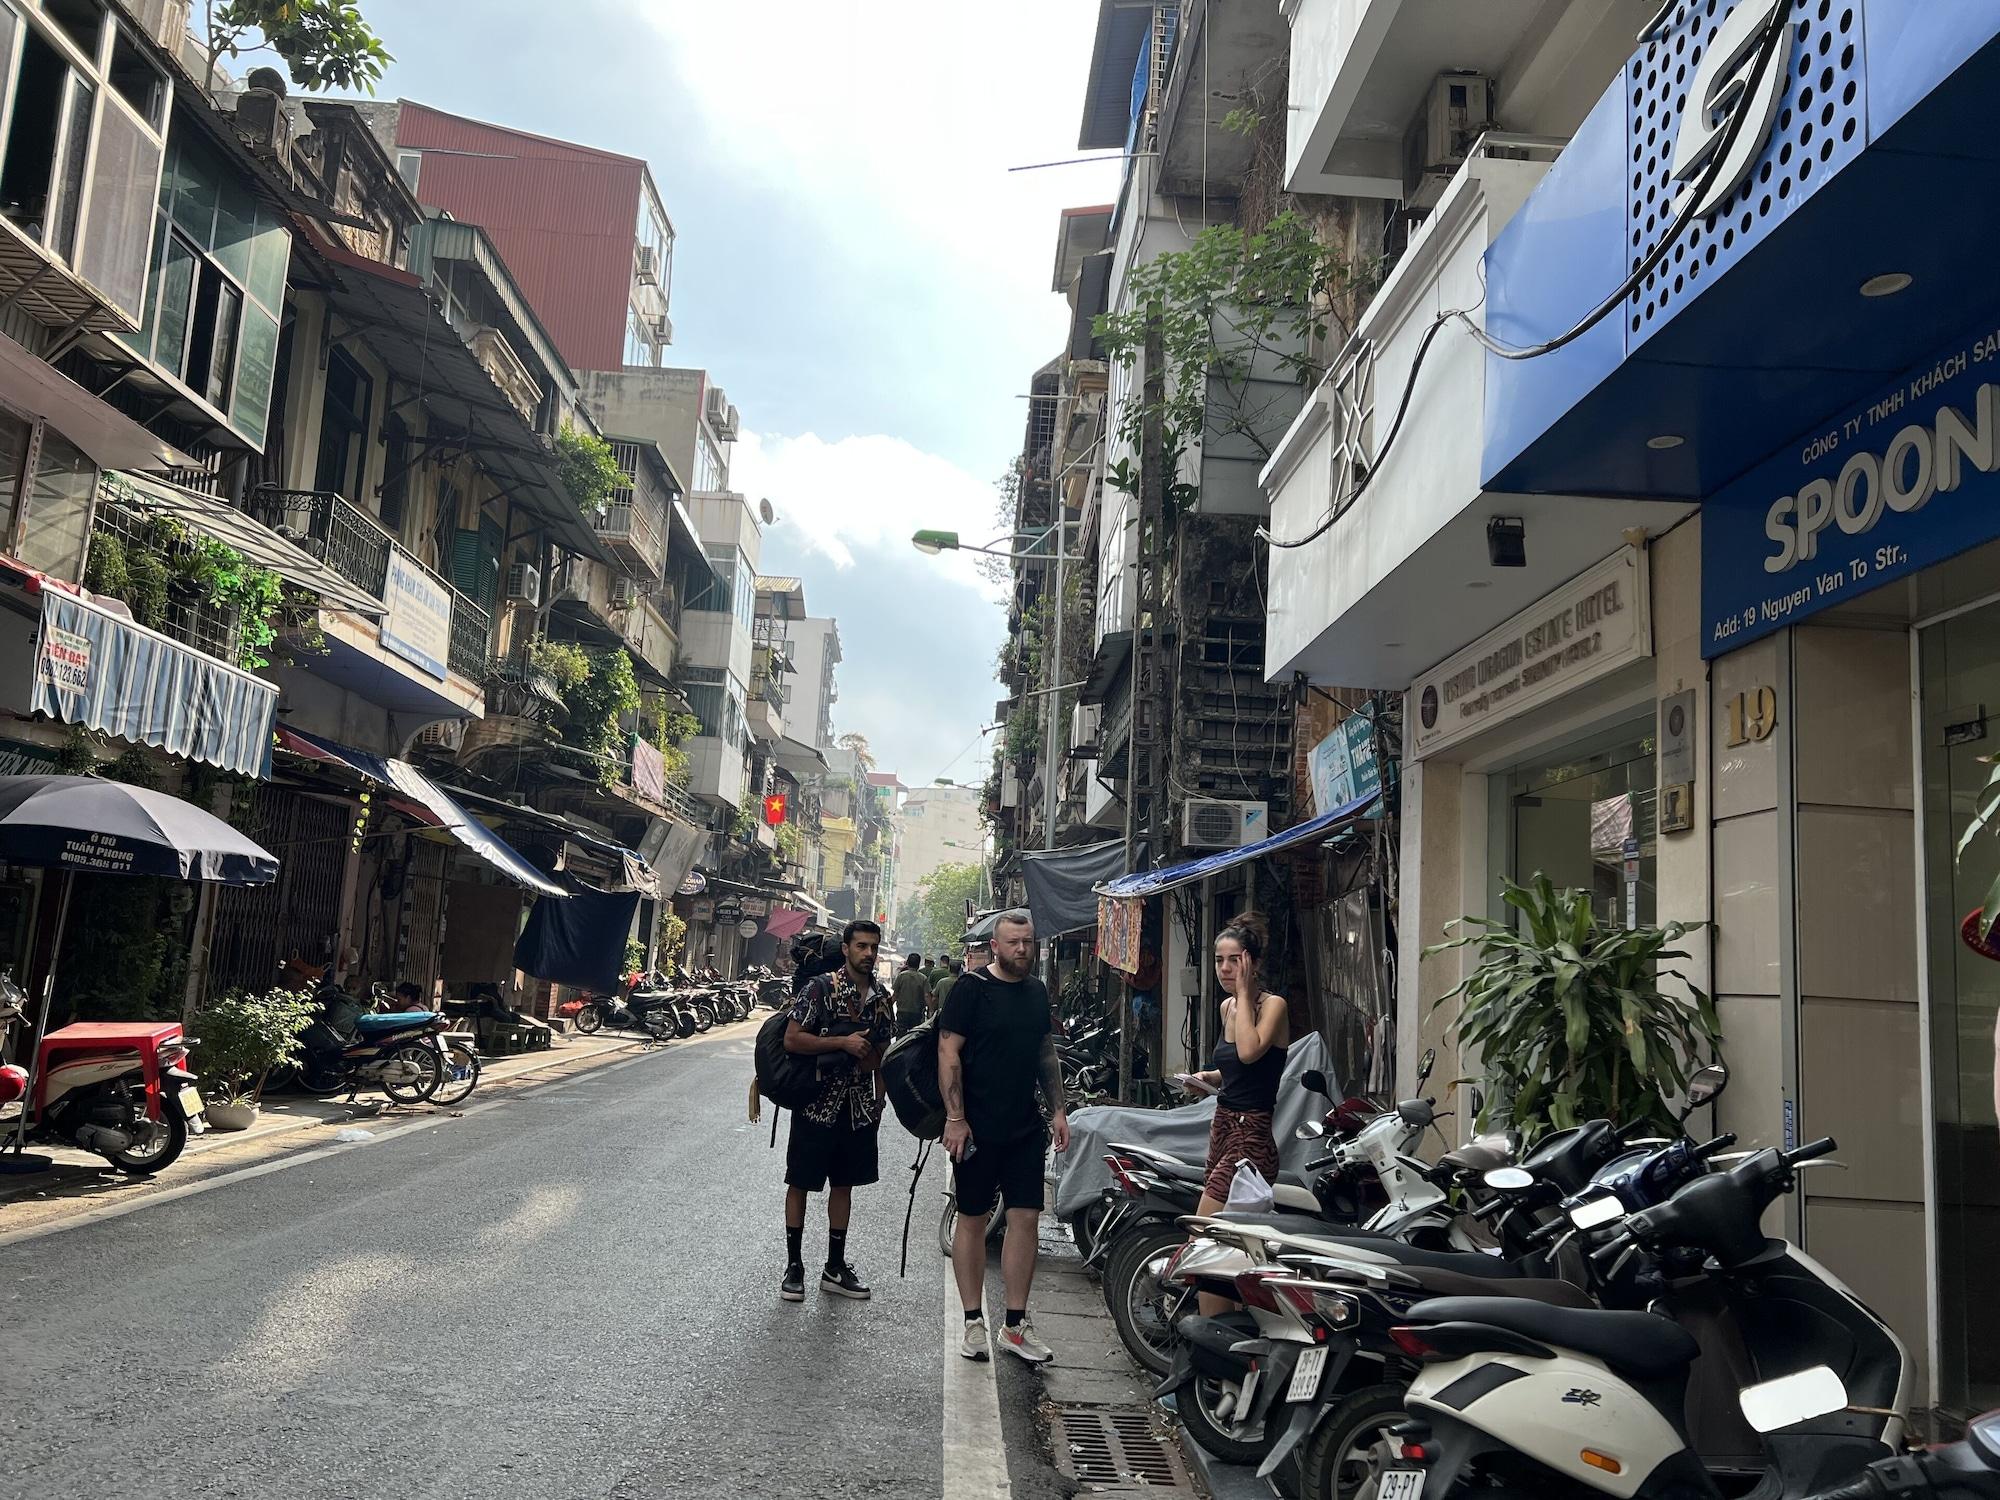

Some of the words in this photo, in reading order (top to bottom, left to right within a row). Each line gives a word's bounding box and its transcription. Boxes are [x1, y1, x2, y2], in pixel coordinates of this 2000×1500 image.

[1802, 430, 1839, 465] CÔNG
[1844, 416, 1863, 441] TY
[1867, 389, 1905, 426] TNHH
[1911, 350, 1967, 400] KHÁCH
[1714, 613, 1741, 642] Add:
[1743, 608, 1756, 626] 19
[1761, 586, 1811, 622] Nguyen
[1816, 571, 1844, 597] Van
[1849, 557, 1868, 582] To
[1875, 544, 1909, 571] Str.,
[1726, 684, 1777, 750] 19
